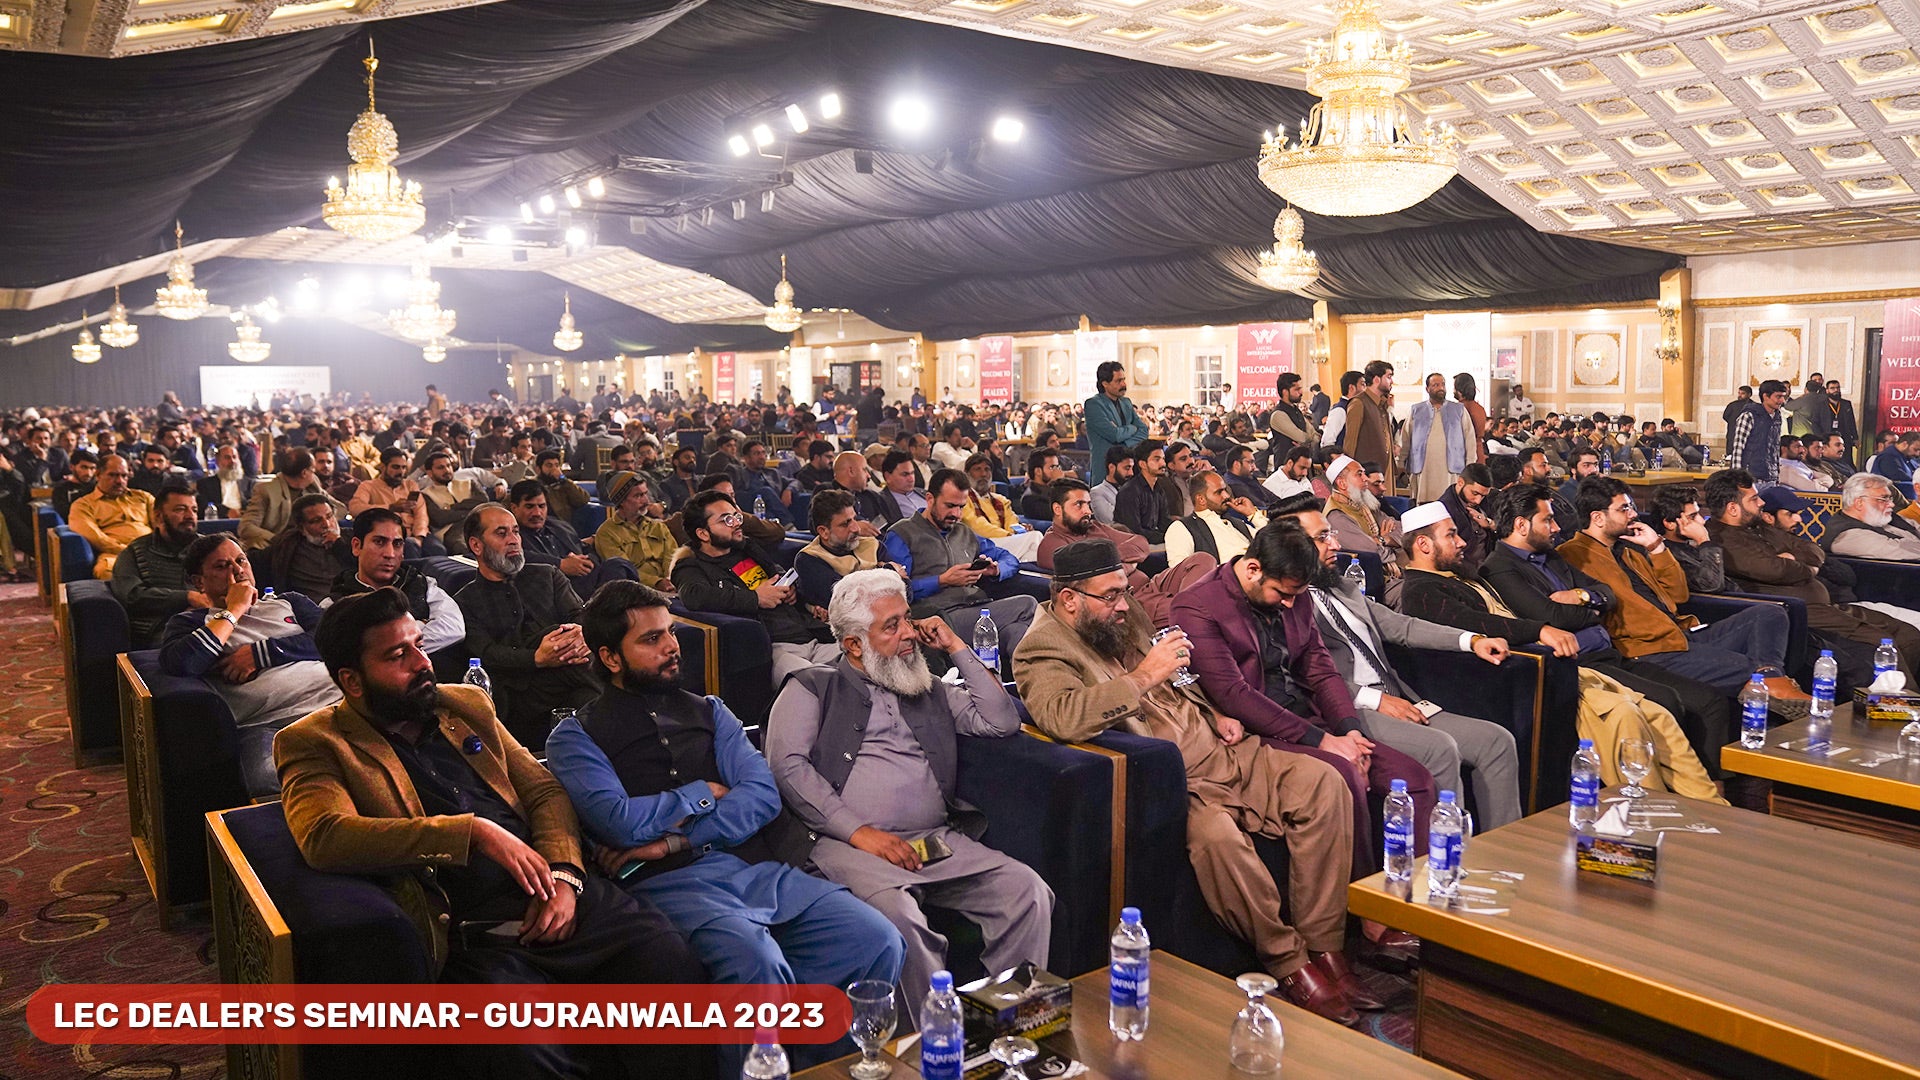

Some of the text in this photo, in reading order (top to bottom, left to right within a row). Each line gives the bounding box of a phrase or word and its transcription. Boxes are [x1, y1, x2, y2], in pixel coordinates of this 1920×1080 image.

[1240, 365, 1289, 374] WELCOME TO
[983, 388, 1008, 397] DEALER'S
[1243, 388, 1277, 398] DEALER
